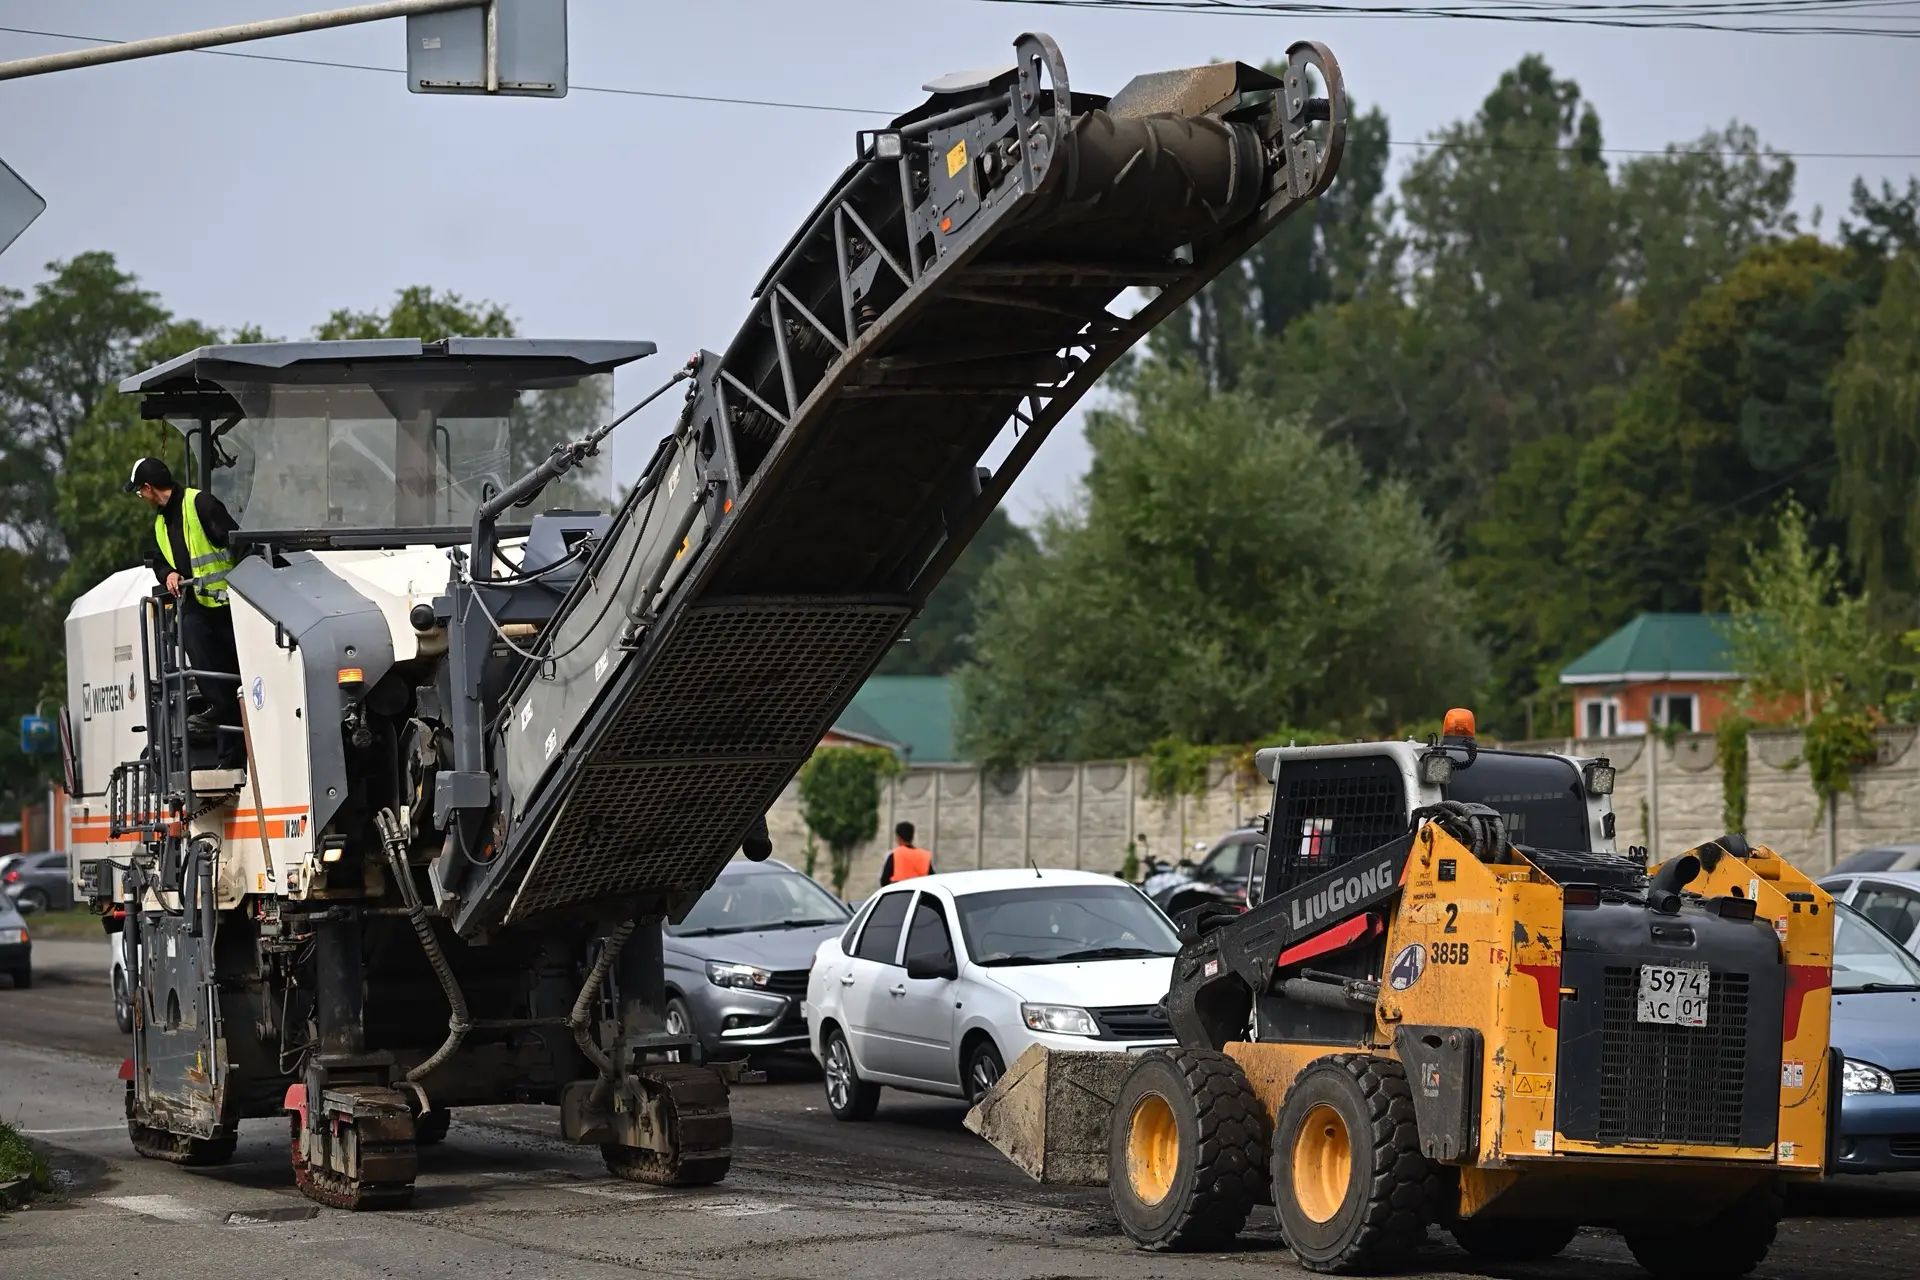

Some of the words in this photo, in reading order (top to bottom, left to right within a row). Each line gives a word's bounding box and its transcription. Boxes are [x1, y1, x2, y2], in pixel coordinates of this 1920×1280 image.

[92, 684, 124, 714] WIRTGEN
[1444, 903, 1458, 933] 2
[1430, 942, 1469, 965] 385B
[1650, 969, 1701, 995] 5974
[1682, 999, 1702, 1017] 01
